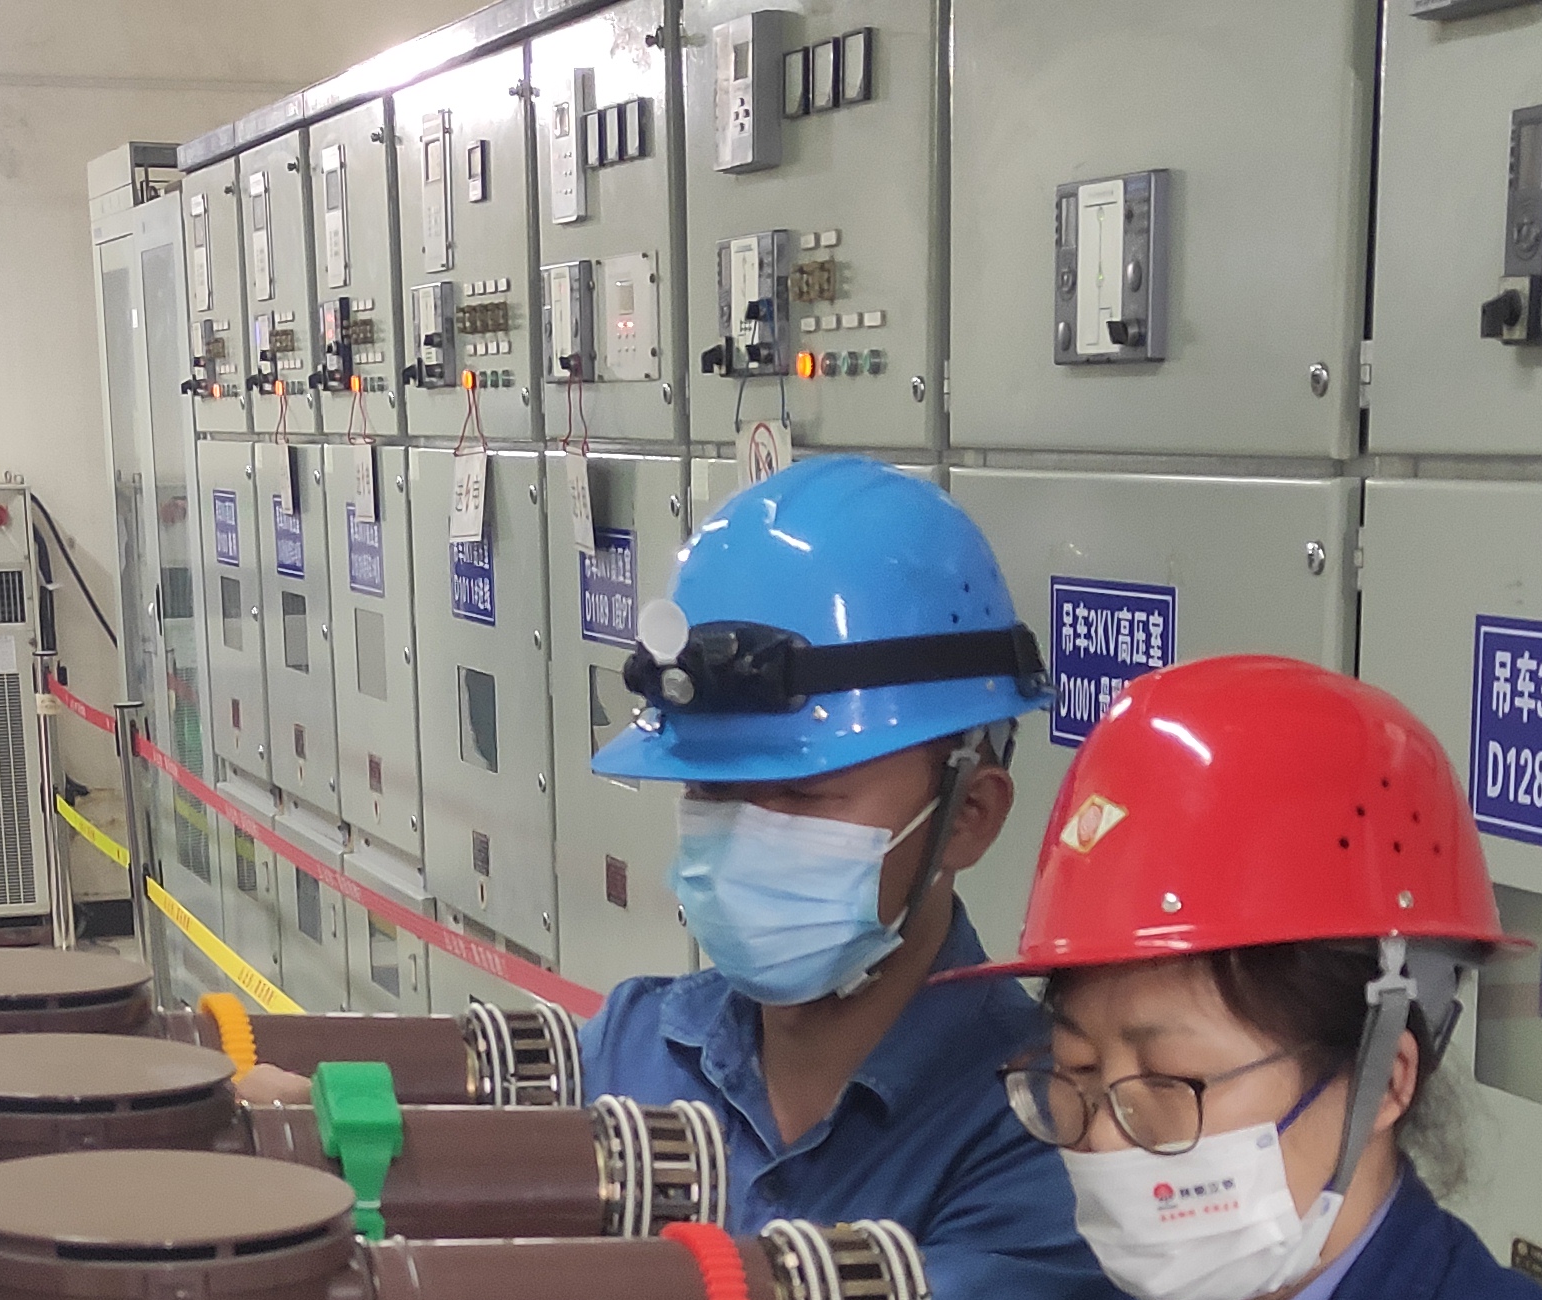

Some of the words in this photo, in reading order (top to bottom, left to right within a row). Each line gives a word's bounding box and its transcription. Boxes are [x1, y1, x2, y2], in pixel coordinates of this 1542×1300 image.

[1062, 601, 1164, 668] 吊车3KV高压室
[1060, 672, 1095, 723] D1001
